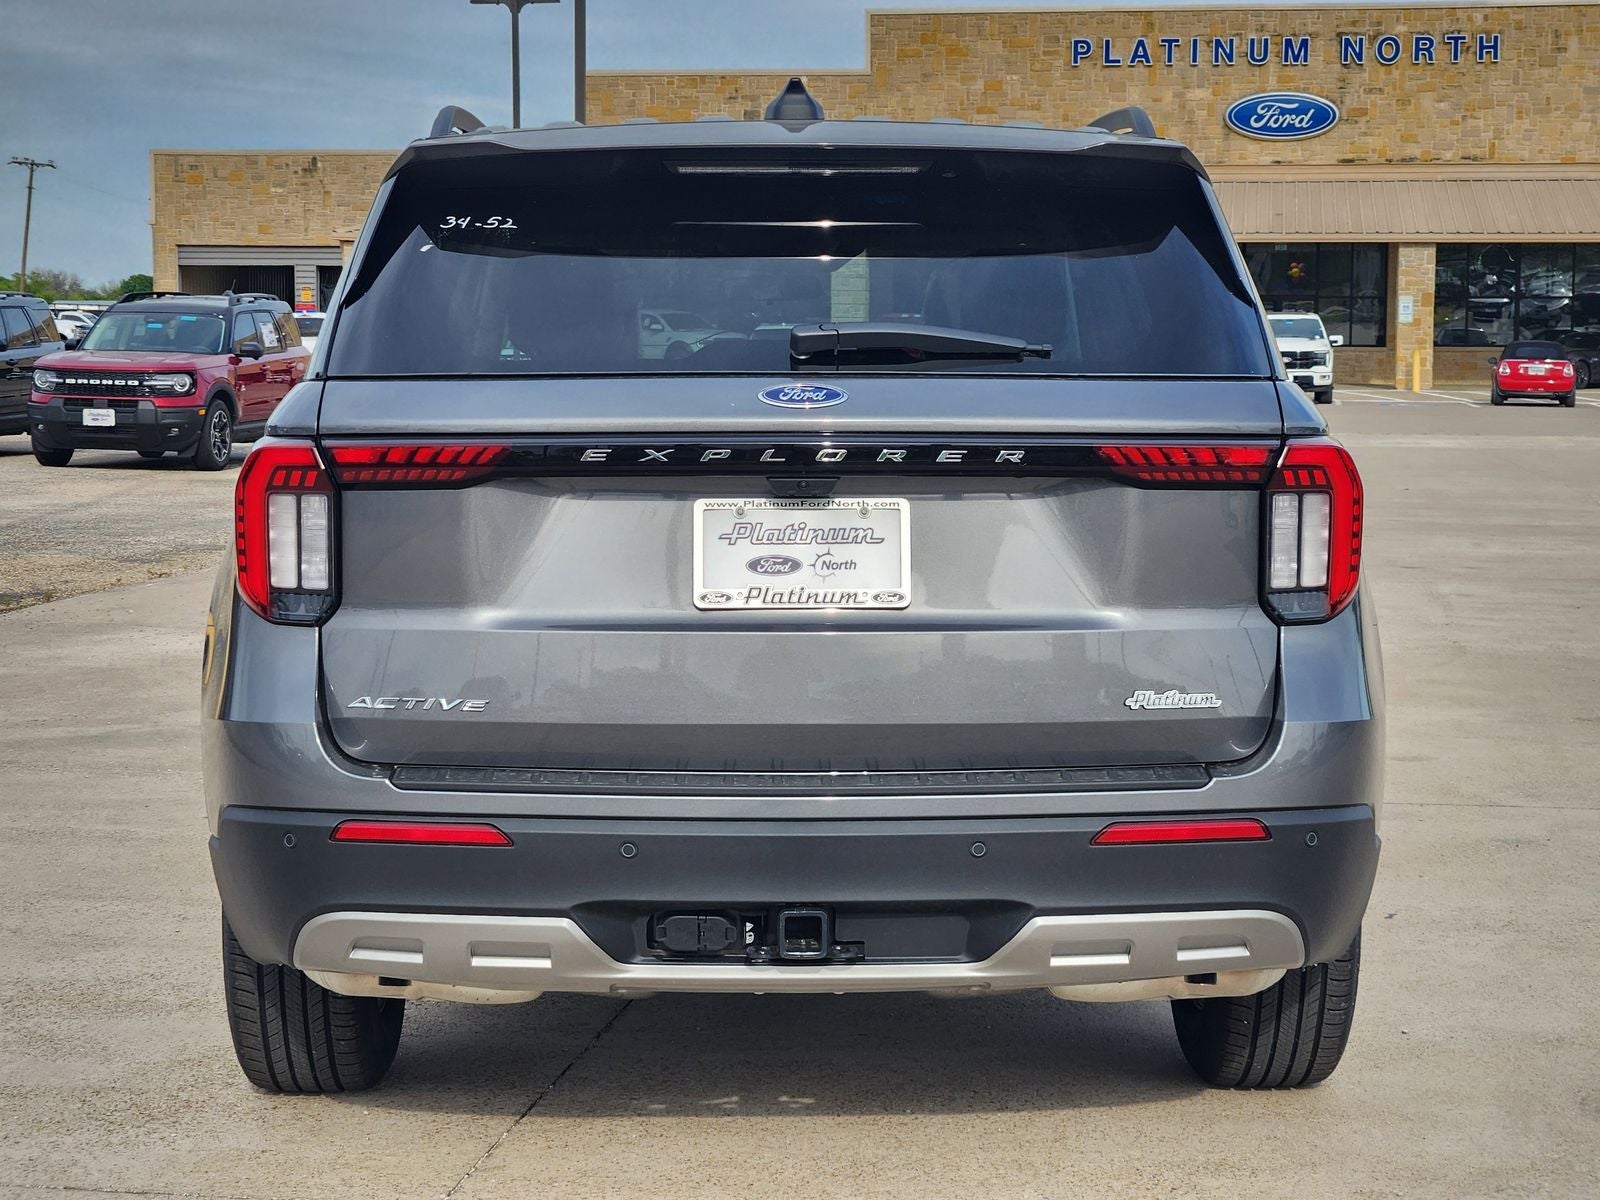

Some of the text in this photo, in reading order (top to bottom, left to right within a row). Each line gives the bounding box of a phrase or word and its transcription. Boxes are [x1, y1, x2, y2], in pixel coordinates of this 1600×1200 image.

[1071, 34, 1500, 66] PLATINUM NORTH
[1250, 102, 1315, 129] Ford
[439, 216, 518, 229] 34-52
[779, 385, 827, 400] Ford
[580, 449, 1025, 462] EXPLORER
[704, 500, 900, 508] www.PlatinumFordNorth.com
[718, 522, 885, 546] Platinum
[757, 558, 792, 573] Ford
[820, 559, 857, 571] North
[744, 586, 866, 605] Platinum
[346, 696, 490, 712] ACTIVE
[1124, 690, 1222, 709] Platinum
